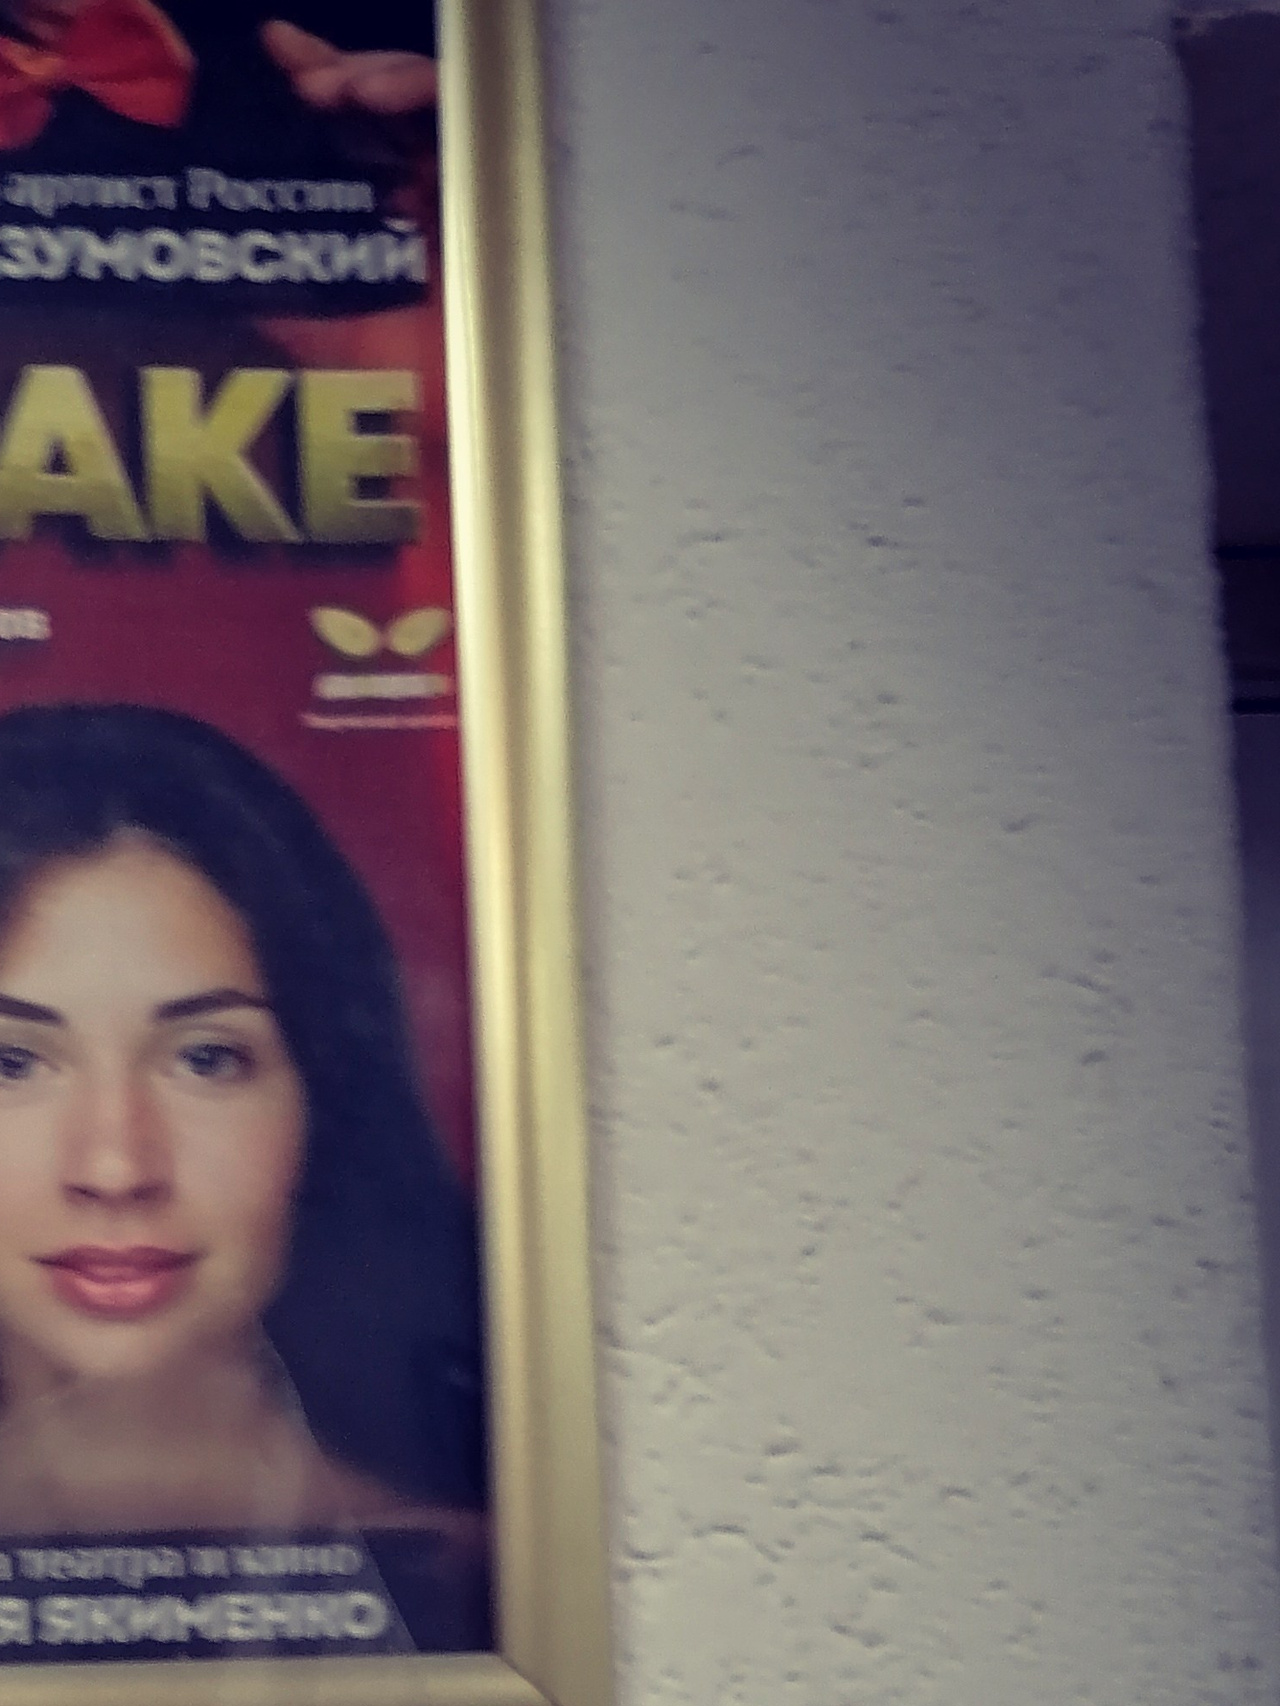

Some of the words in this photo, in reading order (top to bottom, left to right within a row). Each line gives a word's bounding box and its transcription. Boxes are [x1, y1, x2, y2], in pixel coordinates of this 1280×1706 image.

[4, 168, 178, 218] артист
[184, 165, 375, 212] России
[17, 1547, 186, 1589] театра
[187, 1545, 228, 1577] и
[230, 1542, 364, 1577] кино
[34, 1590, 389, 1644] ЯКИМЕНКО
